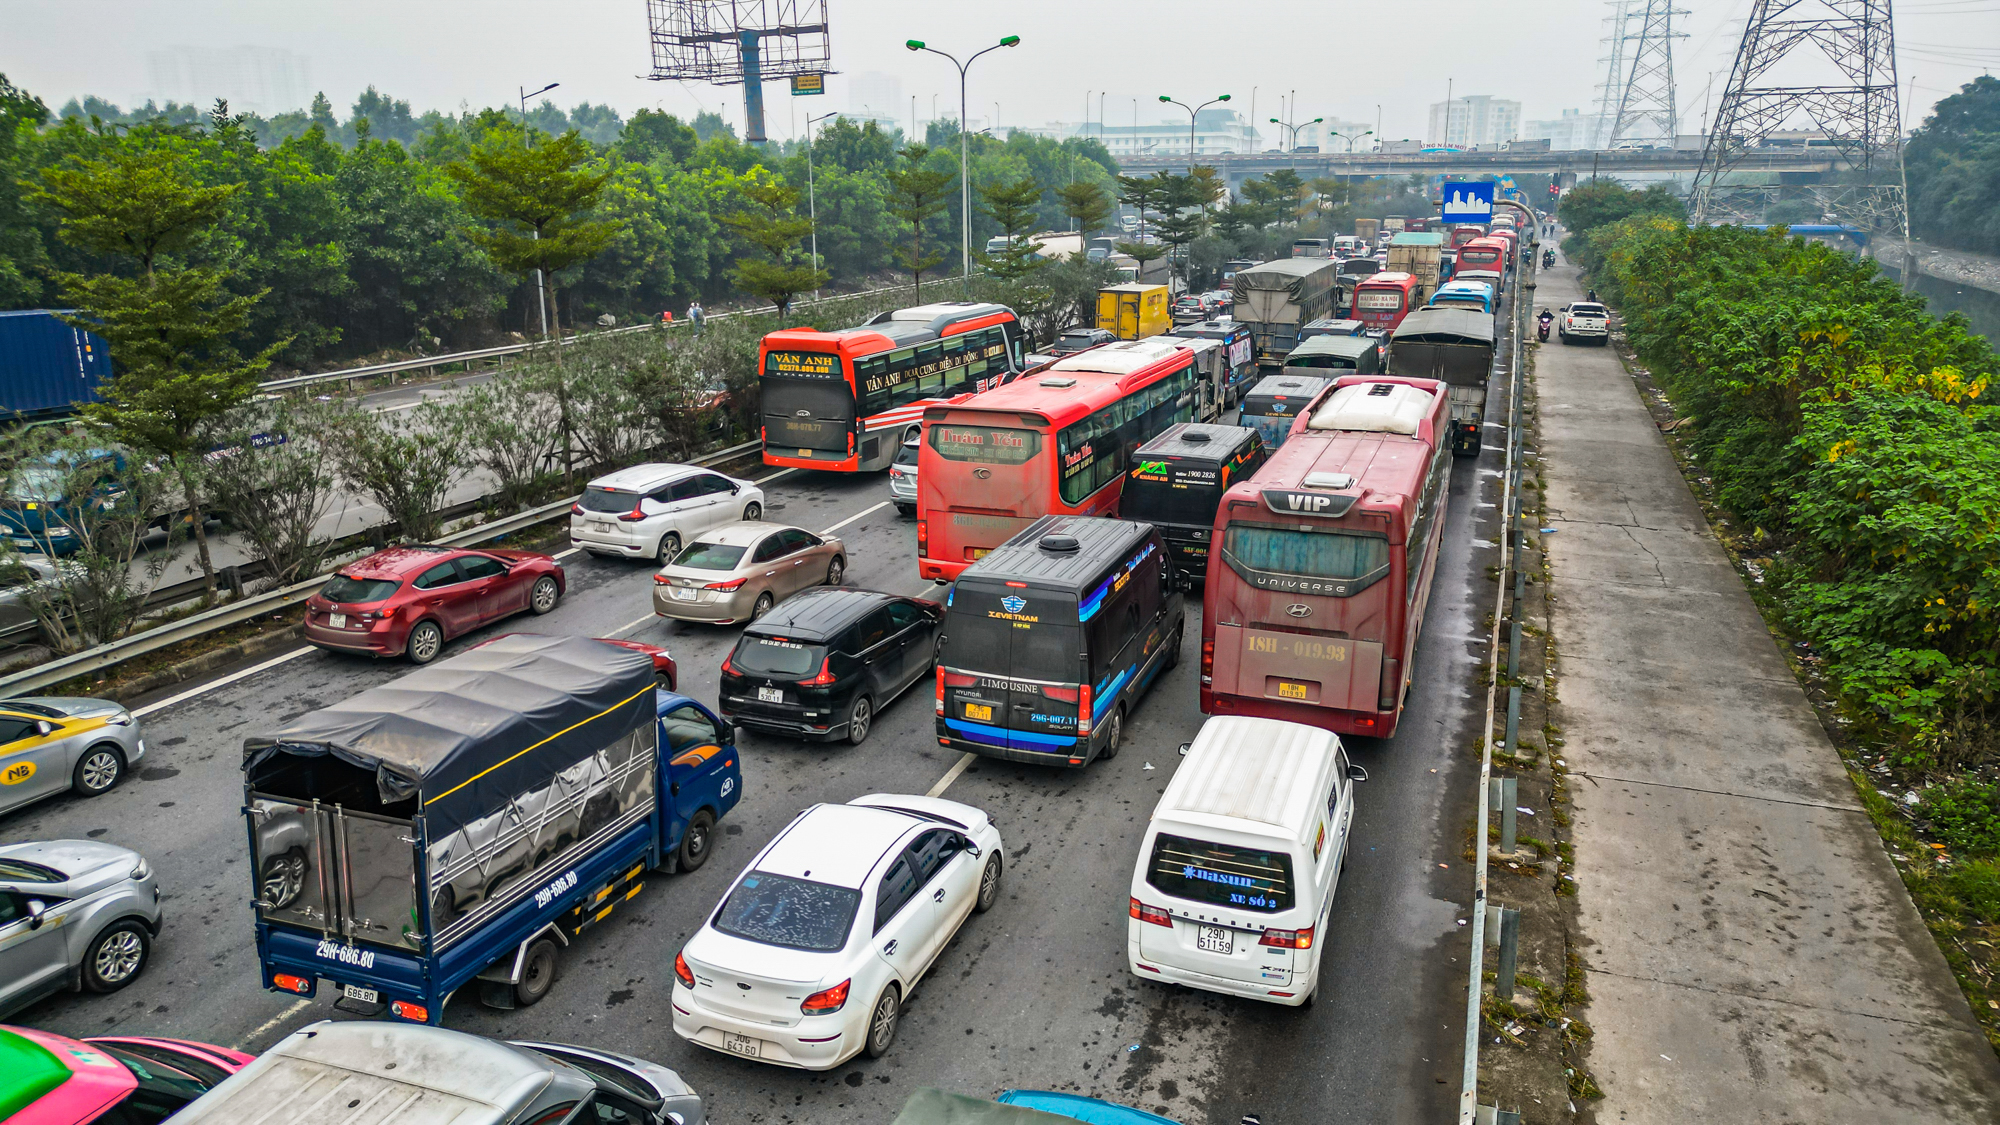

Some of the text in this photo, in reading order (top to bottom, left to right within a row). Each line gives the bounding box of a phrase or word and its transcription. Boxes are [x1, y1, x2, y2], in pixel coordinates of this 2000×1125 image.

[775, 353, 833, 366] VÂN ANH
[866, 375, 883, 392] VÂN
[884, 371, 901, 387] ANH
[919, 362, 938, 377] CUNG
[939, 355, 954, 371] ĐIỆN
[962, 350, 979, 365] ĐỘNG
[940, 428, 1024, 448] Tuân Yến
[1287, 494, 1331, 512] VIP
[1257, 577, 1346, 593] UNIVERSE
[1248, 635, 1278, 653] 18H
[1293, 641, 1346, 661] 019.93
[955, 689, 982, 698] HYUNDAI
[981, 678, 1038, 694] LIMOUSINE
[967, 710, 989, 720] 007.11
[1030, 713, 1077, 725] 29G-007.11
[8, 765, 30, 780] NB
[534, 870, 578, 909] 29H-686.80
[1230, 893, 1246, 904] XE
[1268, 899, 1277, 909] 2
[1207, 927, 1225, 940] 29D
[1199, 937, 1231, 953] 511.59
[316, 940, 375, 969] 29H-686.80
[347, 987, 374, 1002] 686.80
[727, 1037, 756, 1056] 643.60
